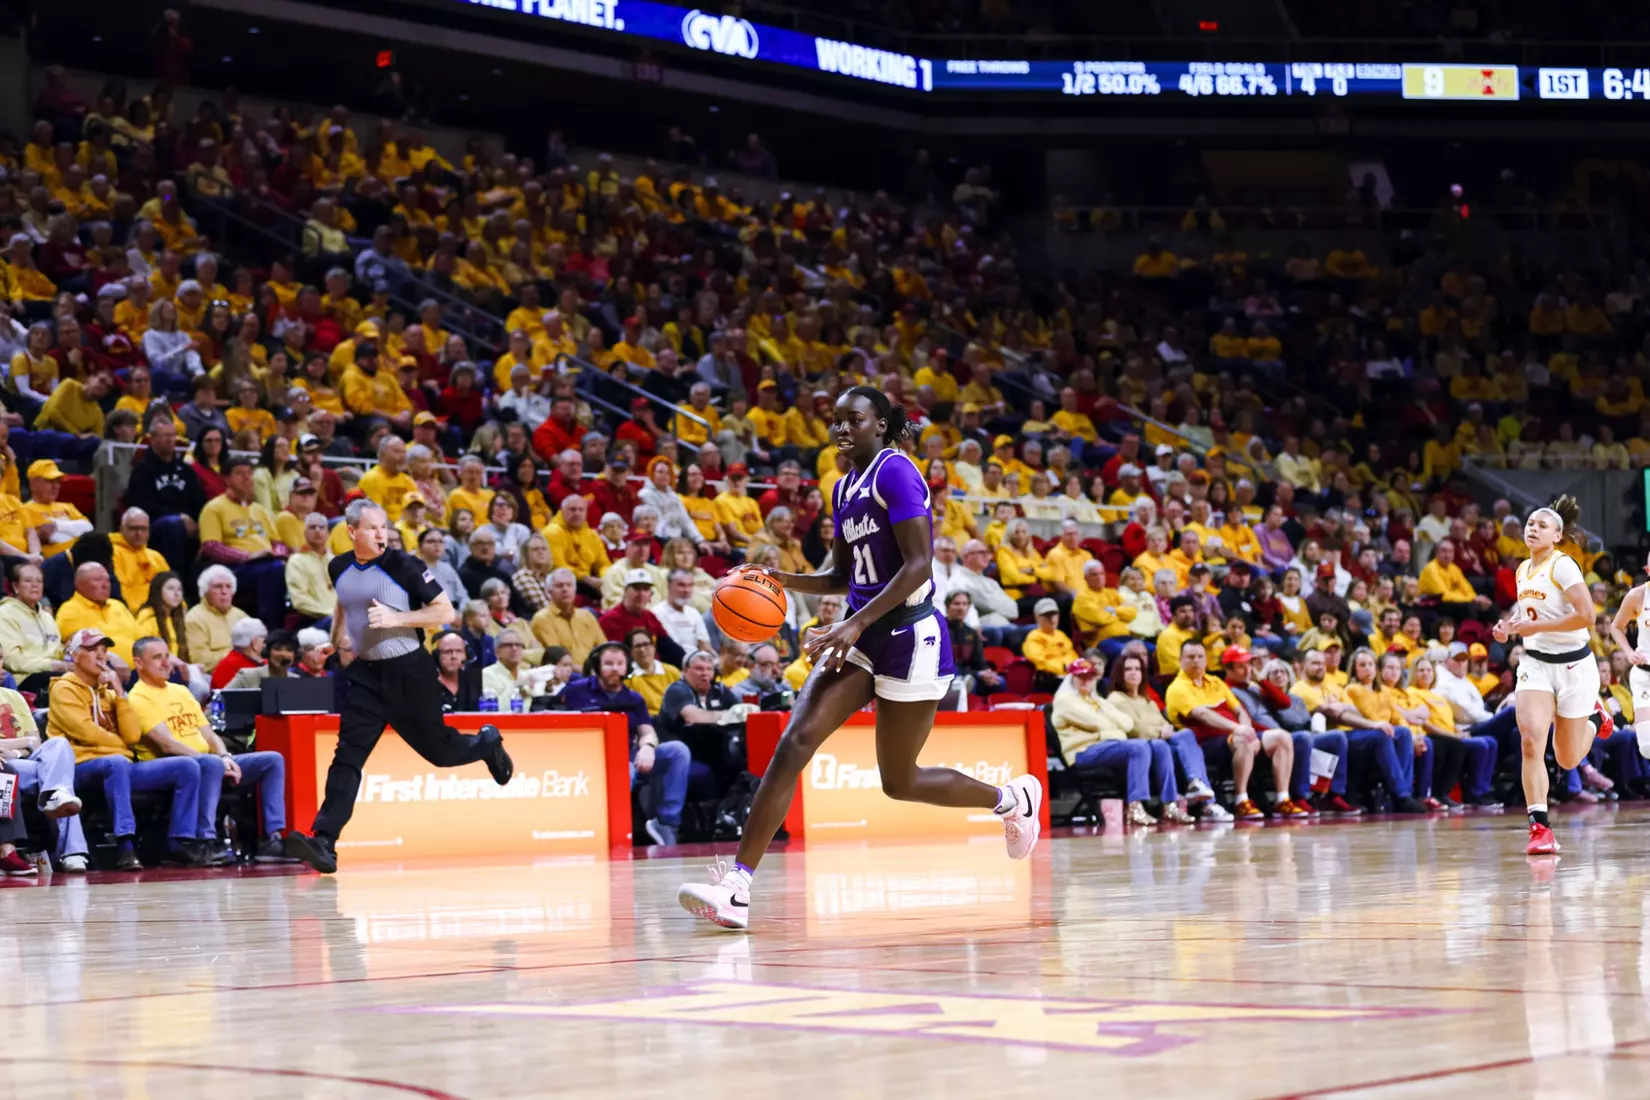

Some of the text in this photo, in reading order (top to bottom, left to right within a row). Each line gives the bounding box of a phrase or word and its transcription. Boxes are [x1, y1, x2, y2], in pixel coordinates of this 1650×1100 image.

[686, 11, 755, 58] CVA
[815, 38, 917, 89] WORKING
[1062, 72, 1161, 95] 1/2 50.0%
[1215, 74, 1278, 96] 66.7%
[1547, 74, 1582, 94] 1ST
[853, 543, 879, 584] 21
[743, 574, 781, 597] ELITE
[365, 774, 423, 802] First
[541, 769, 591, 798] Bank
[976, 761, 1014, 786] Bank
